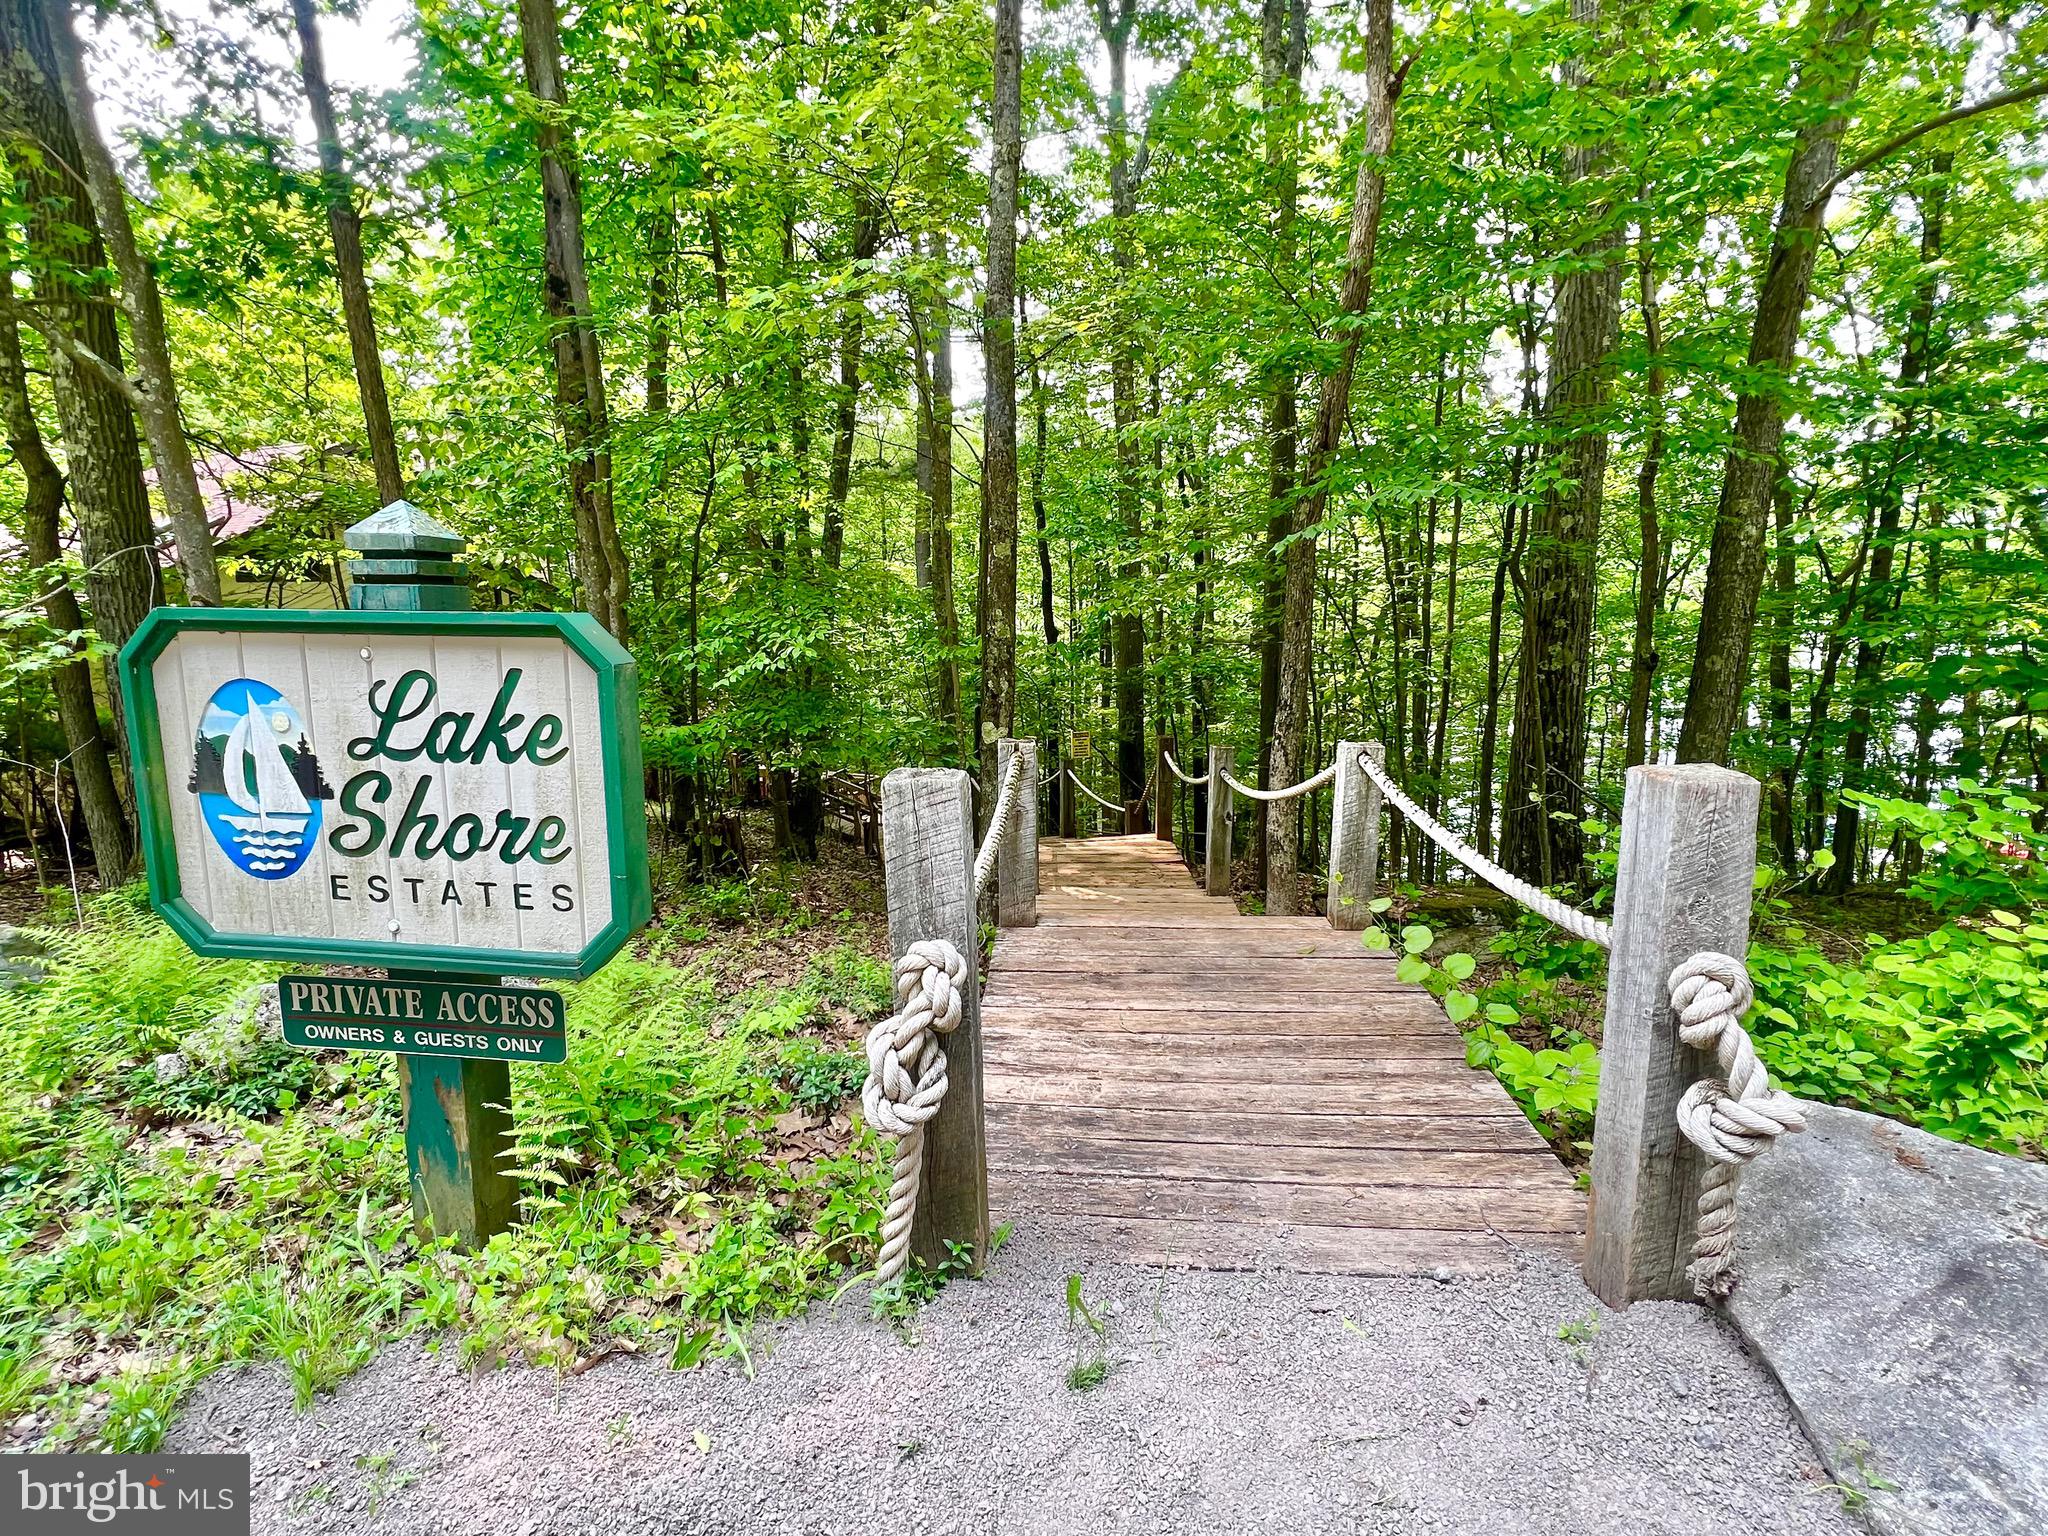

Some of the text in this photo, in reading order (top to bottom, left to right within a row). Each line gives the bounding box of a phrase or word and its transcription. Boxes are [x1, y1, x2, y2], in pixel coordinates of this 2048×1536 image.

[347, 668, 570, 767] Lake
[328, 770, 573, 865] Shore
[330, 875, 574, 912] ESTATES
[288, 982, 555, 1028] PRIVATE ACCESS
[304, 1024, 544, 1054] OWNERS & GUESTS ONLY
